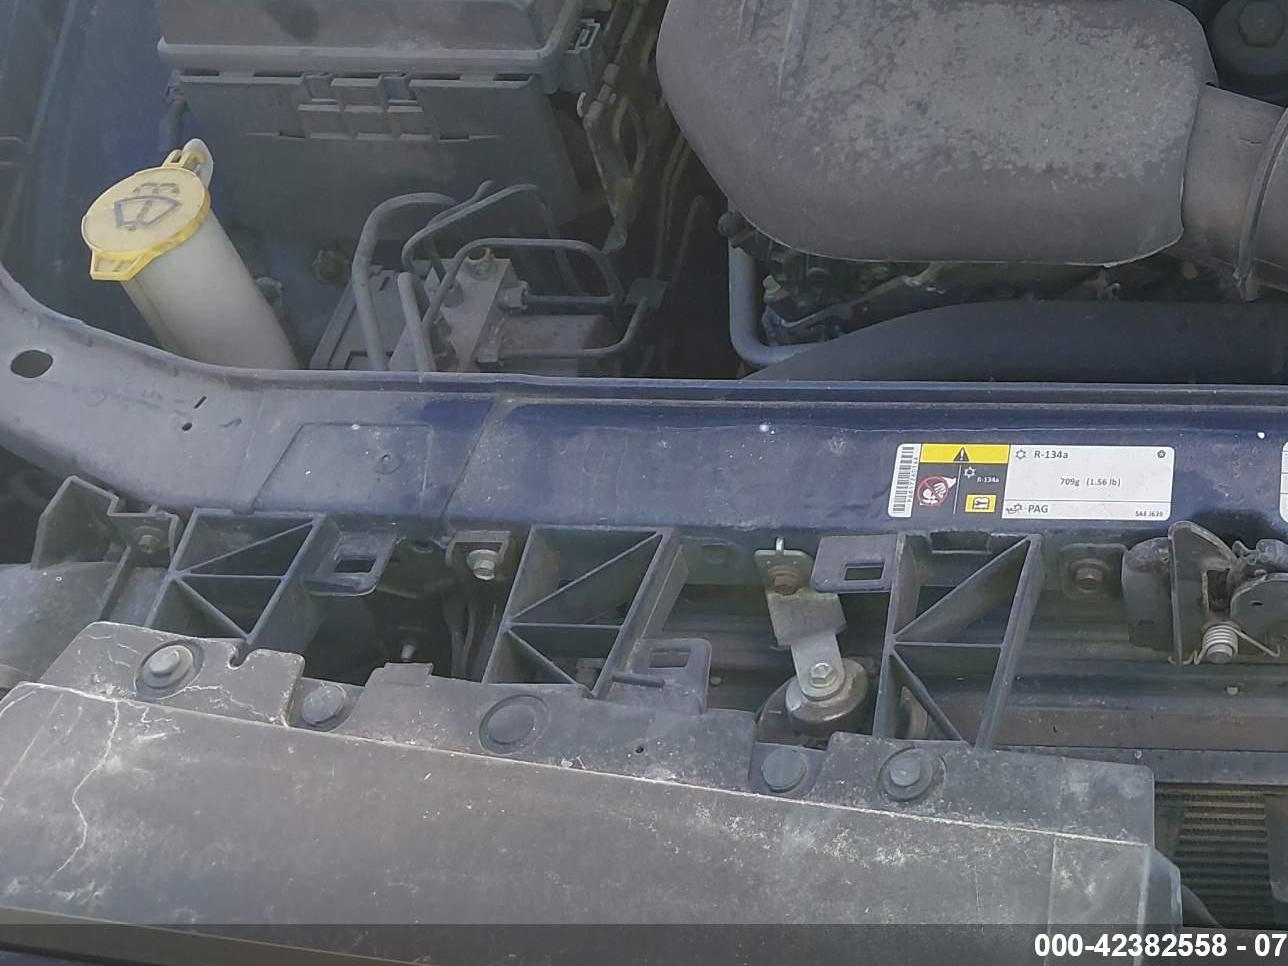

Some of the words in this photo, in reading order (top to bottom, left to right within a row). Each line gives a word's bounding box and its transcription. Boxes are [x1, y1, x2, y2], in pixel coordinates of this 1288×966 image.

[1034, 449, 1069, 459] R-134a
[1060, 478, 1080, 487] 709g
[1086, 477, 1108, 487] (1.56
[1109, 478, 1121, 488] lb)
[1028, 503, 1048, 514] PAG
